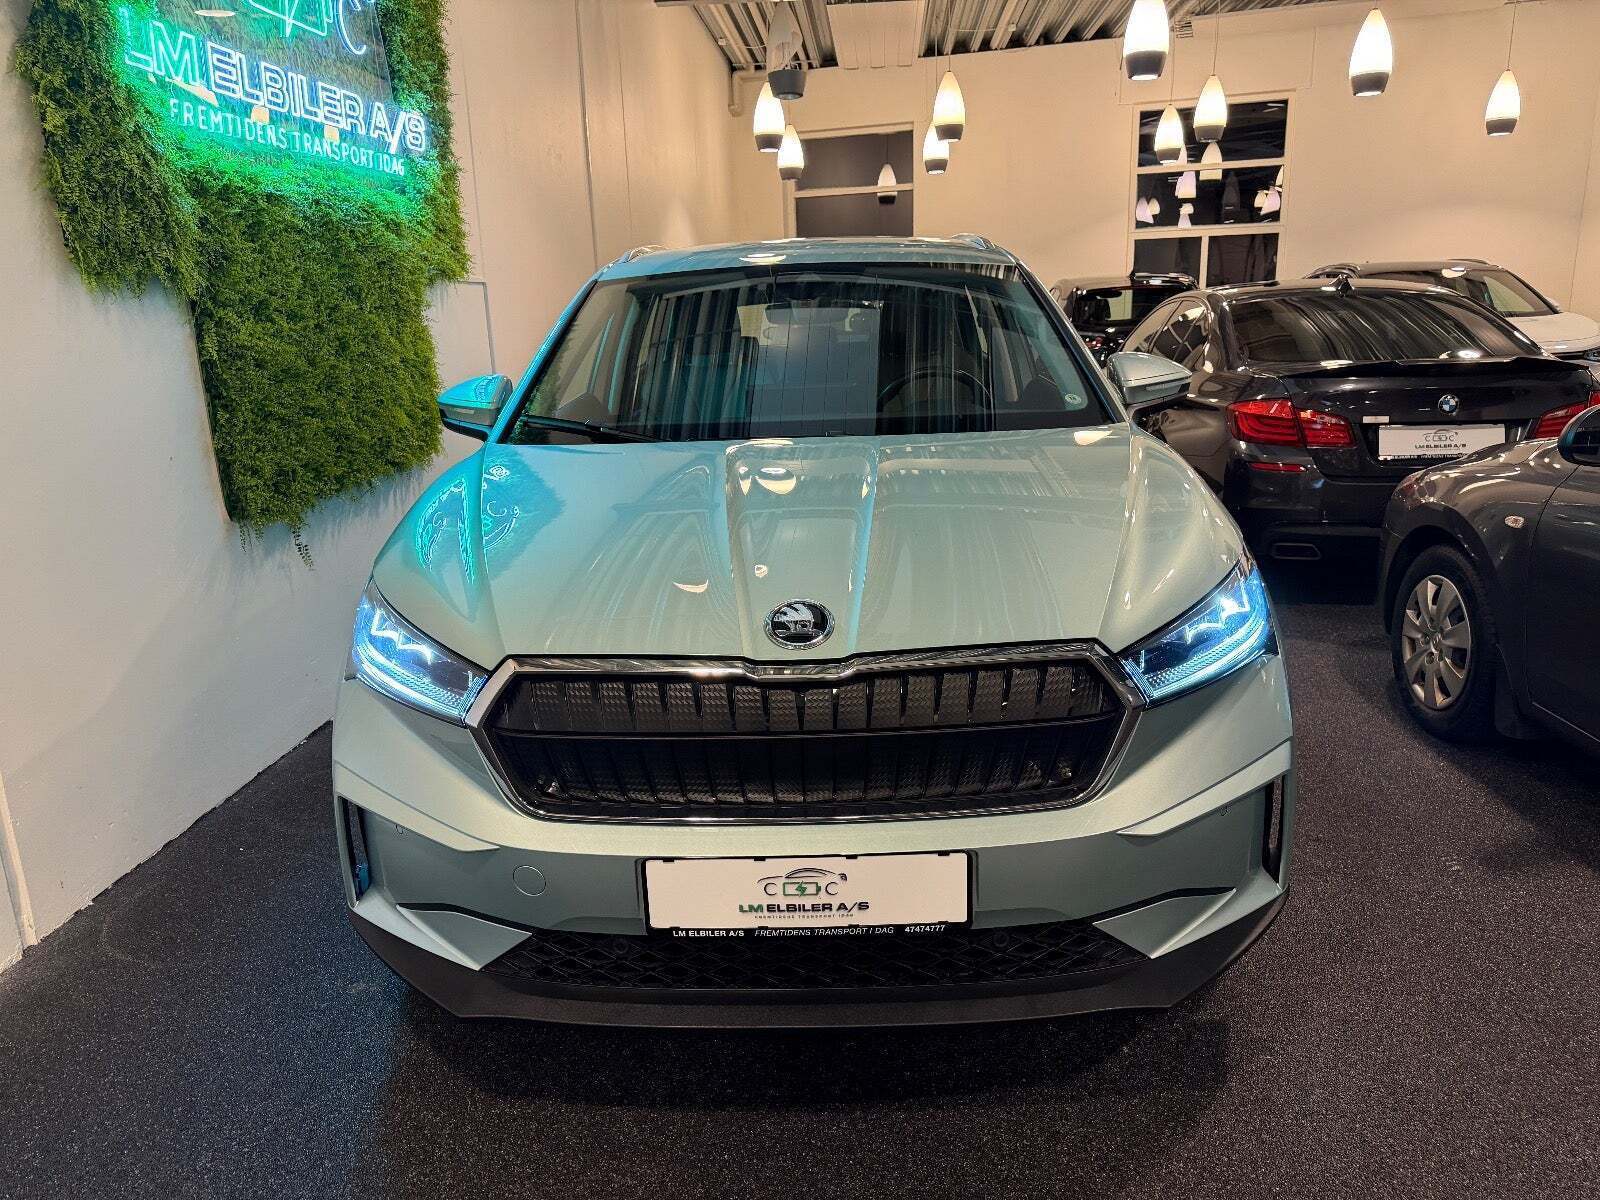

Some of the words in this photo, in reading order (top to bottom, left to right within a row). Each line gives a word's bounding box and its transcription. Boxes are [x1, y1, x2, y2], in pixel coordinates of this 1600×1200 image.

[118, 6, 200, 85] LM
[207, 41, 366, 135] ELBILER
[370, 101, 425, 155] A/S
[169, 98, 288, 149] FREMTIDENS
[288, 131, 375, 169] TRANSPORT
[738, 903, 764, 913] LM
[766, 903, 833, 913] ELBILER
[836, 901, 870, 912] A/S
[754, 929, 811, 938] FREMTIDENS
[813, 926, 867, 937] TRANSPORT
[874, 926, 894, 935] DAG
[904, 924, 946, 934] 47474777
